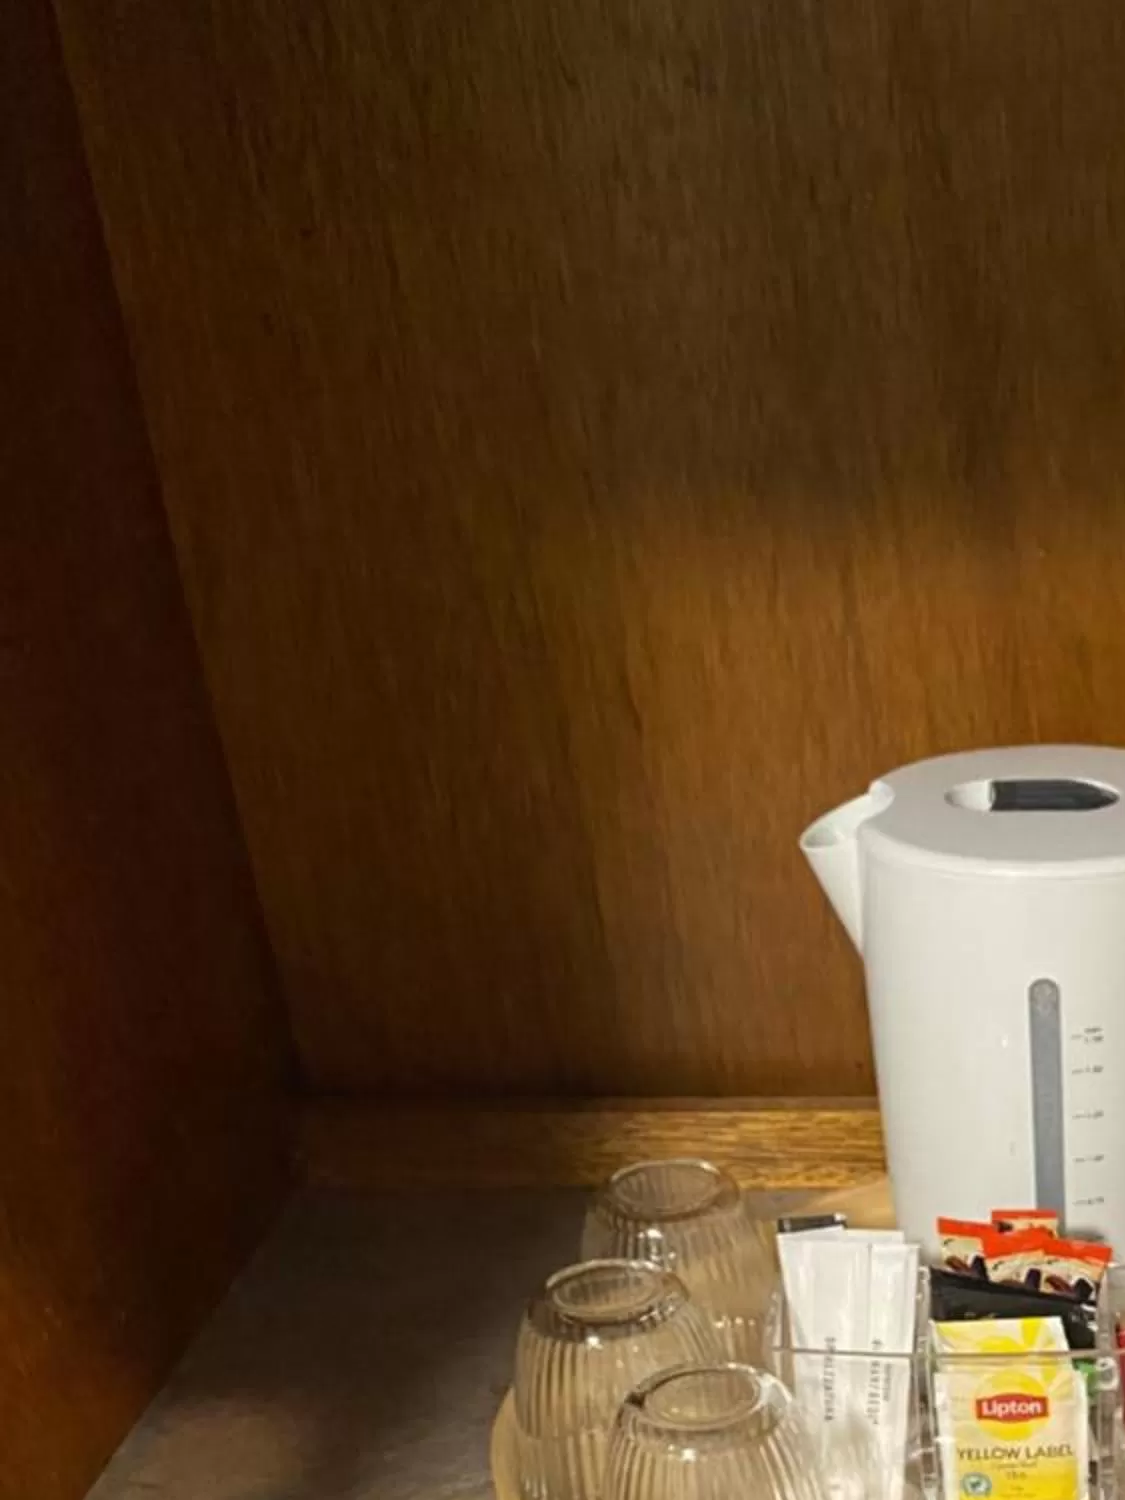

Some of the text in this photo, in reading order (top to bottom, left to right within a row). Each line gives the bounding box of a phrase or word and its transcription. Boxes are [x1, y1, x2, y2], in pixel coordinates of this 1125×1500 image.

[980, 1399, 1042, 1418] Lipton
[956, 1443, 1074, 1461] YELLOW LABEL
